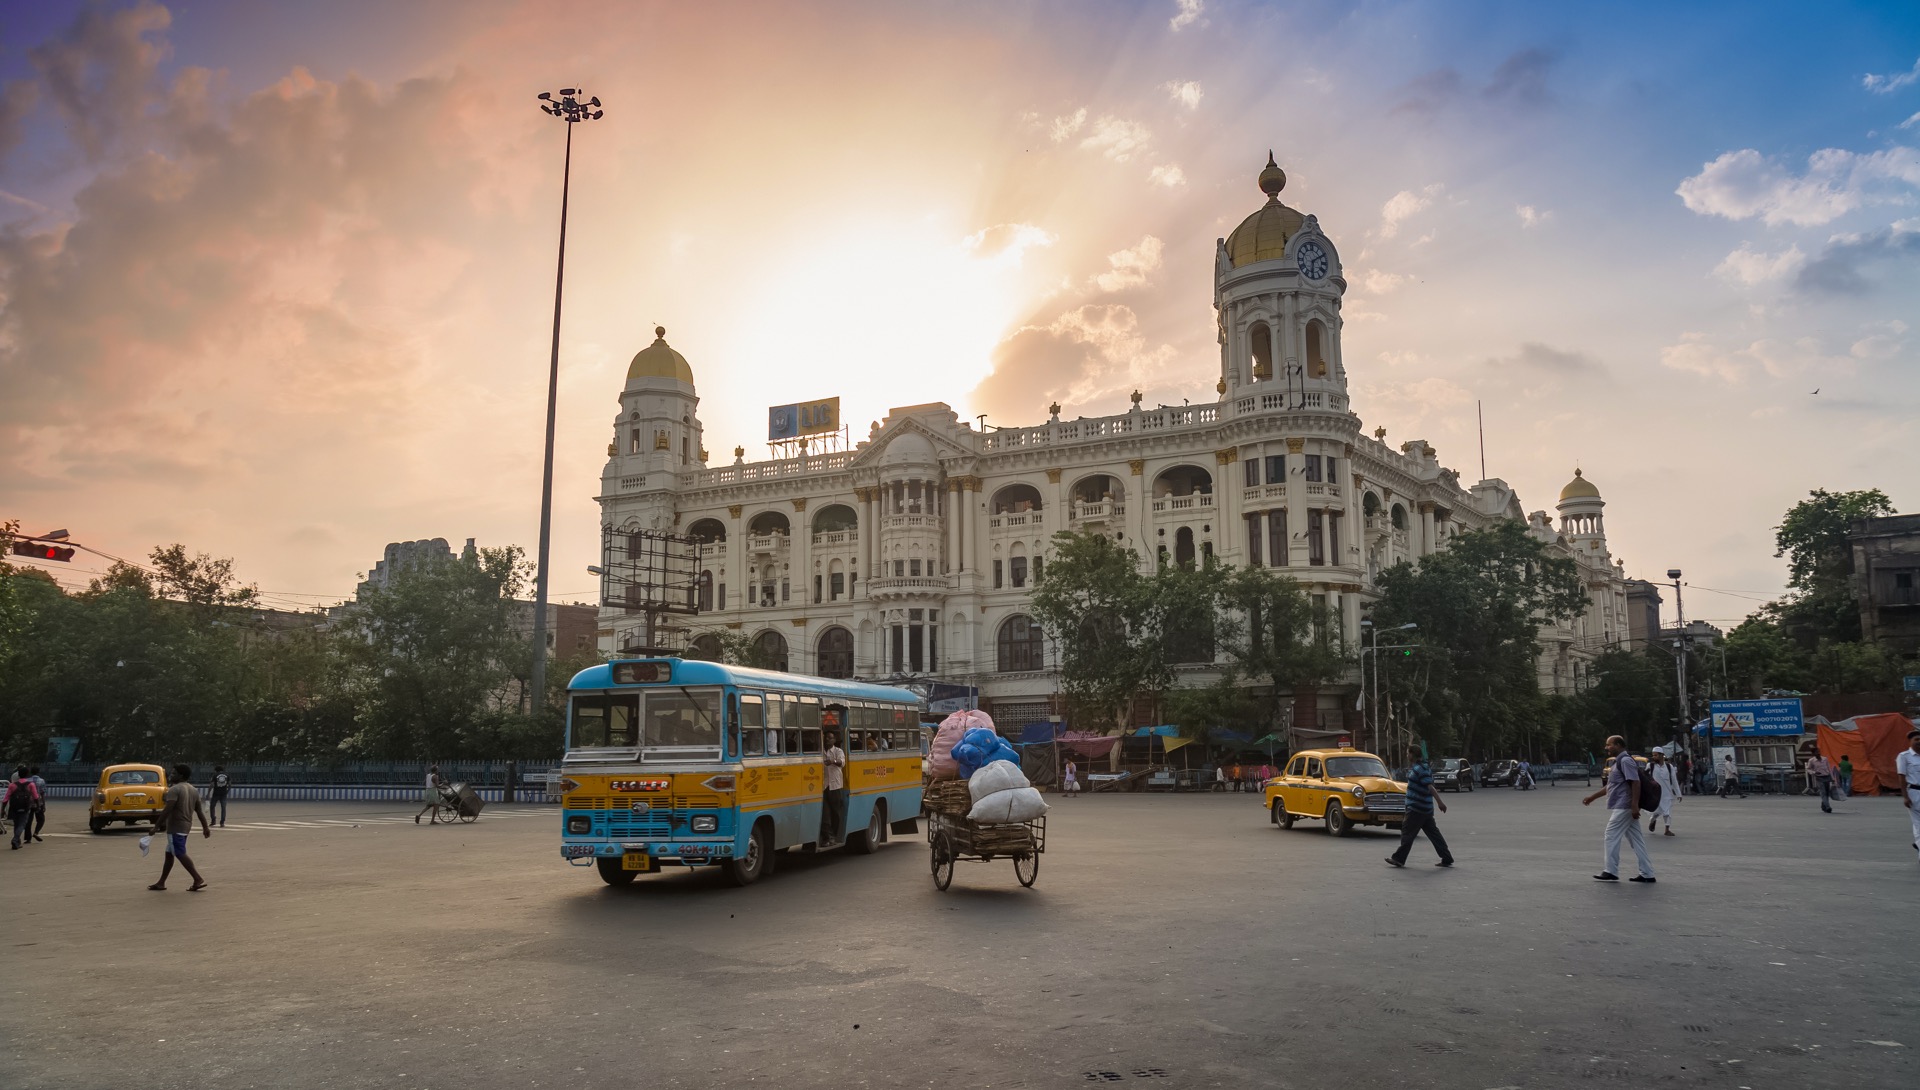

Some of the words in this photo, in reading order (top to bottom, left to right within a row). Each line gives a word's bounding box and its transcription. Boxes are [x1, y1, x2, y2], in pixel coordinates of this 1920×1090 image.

[801, 403, 831, 427] LIC
[612, 781, 668, 789] EICHER
[568, 845, 595, 855] SPEED
